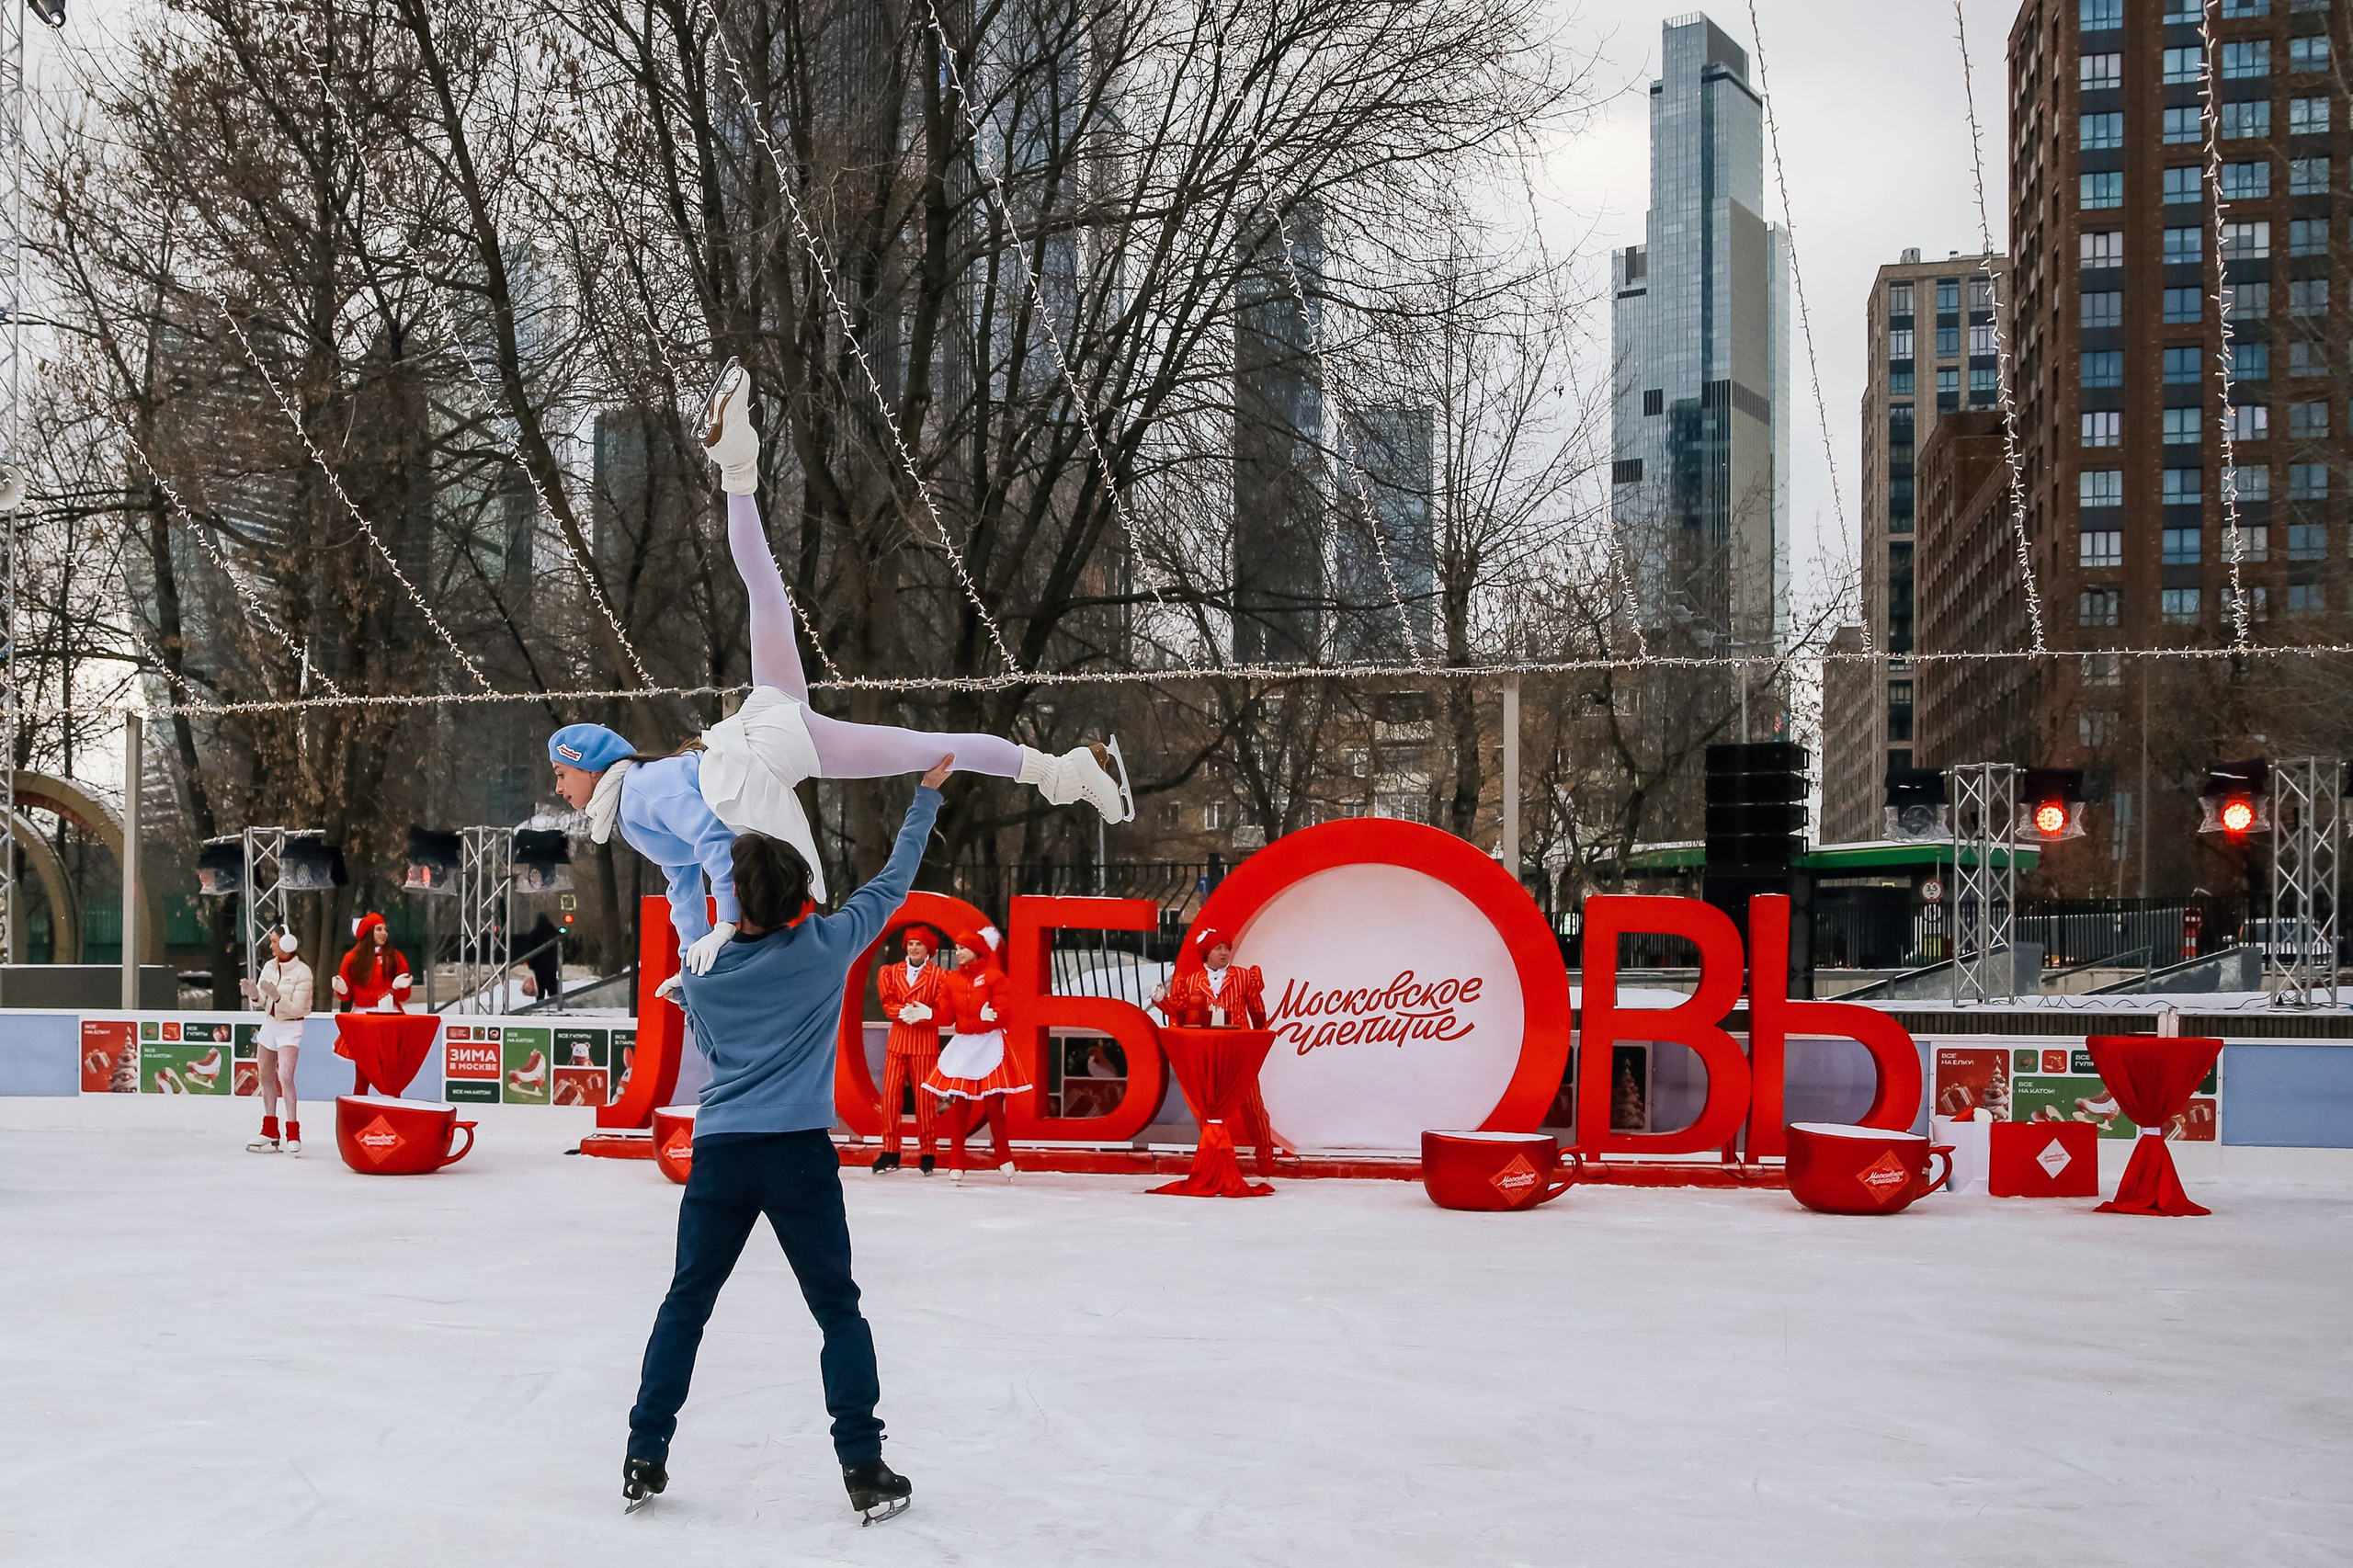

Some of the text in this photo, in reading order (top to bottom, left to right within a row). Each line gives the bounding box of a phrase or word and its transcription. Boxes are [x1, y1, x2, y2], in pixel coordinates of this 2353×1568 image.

[1266, 970, 1483, 1027] Московское
[449, 1048, 497, 1062] ЗИМА
[458, 1062, 497, 1072] МОСКВЕ
